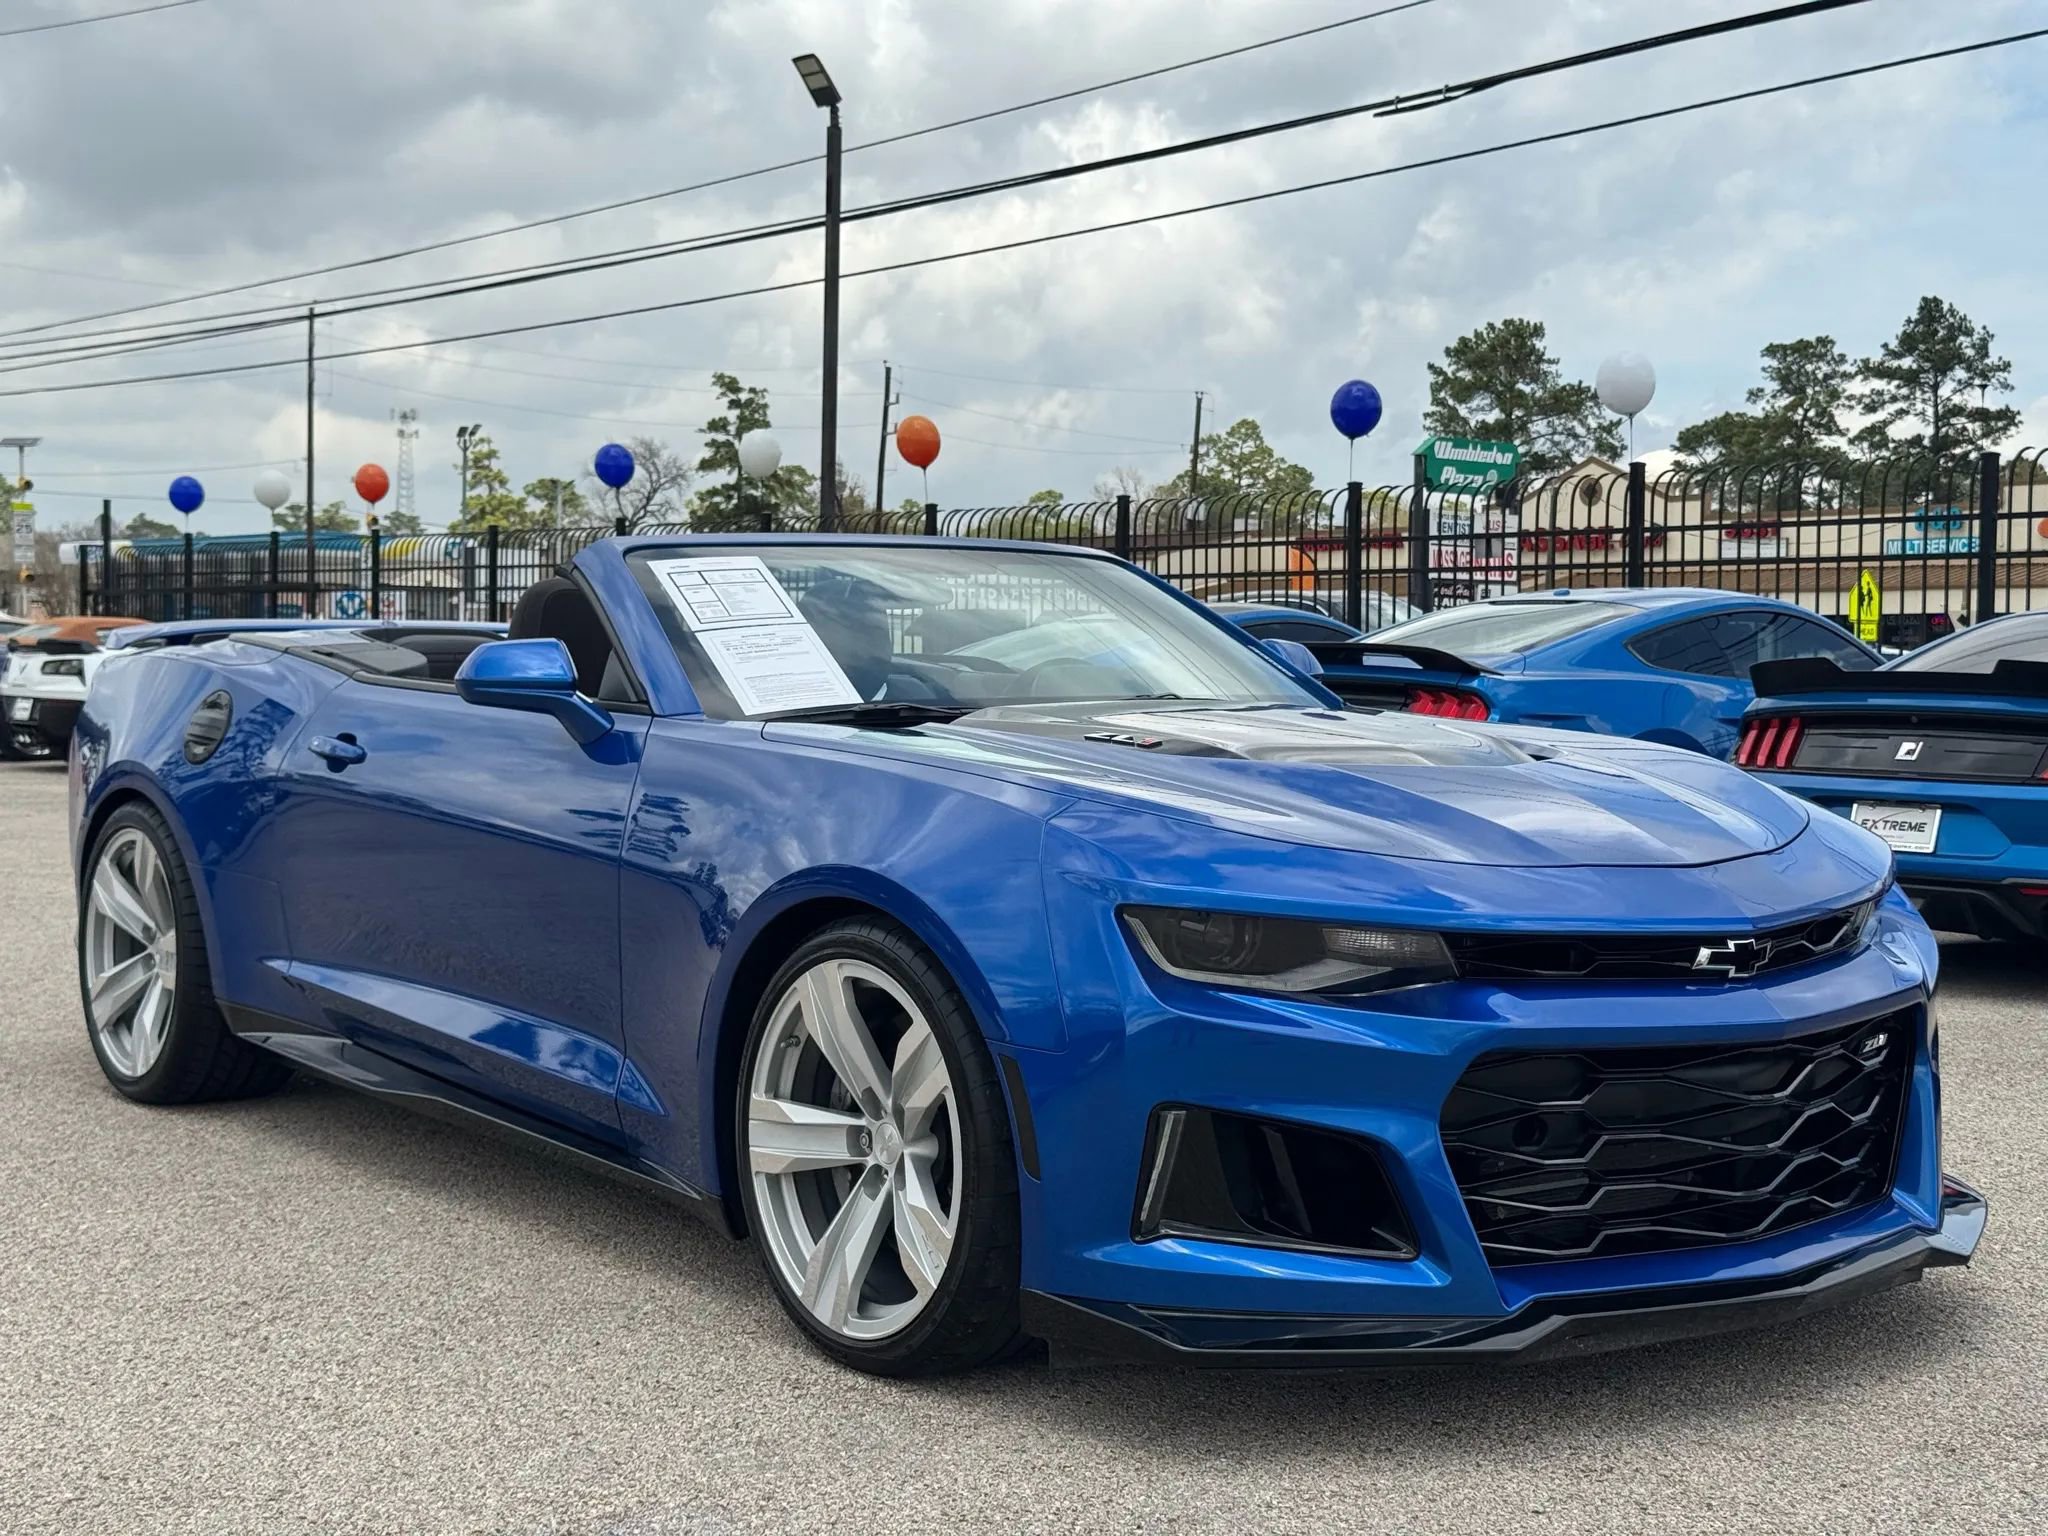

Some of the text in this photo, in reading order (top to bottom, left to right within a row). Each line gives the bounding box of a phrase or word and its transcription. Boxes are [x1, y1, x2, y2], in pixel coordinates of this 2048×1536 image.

[1440, 465, 1484, 487] Plaza
[1437, 521, 1471, 535] ENIST
[1860, 627, 1875, 636] HEAD
[1861, 819, 1928, 833] EXTREME
